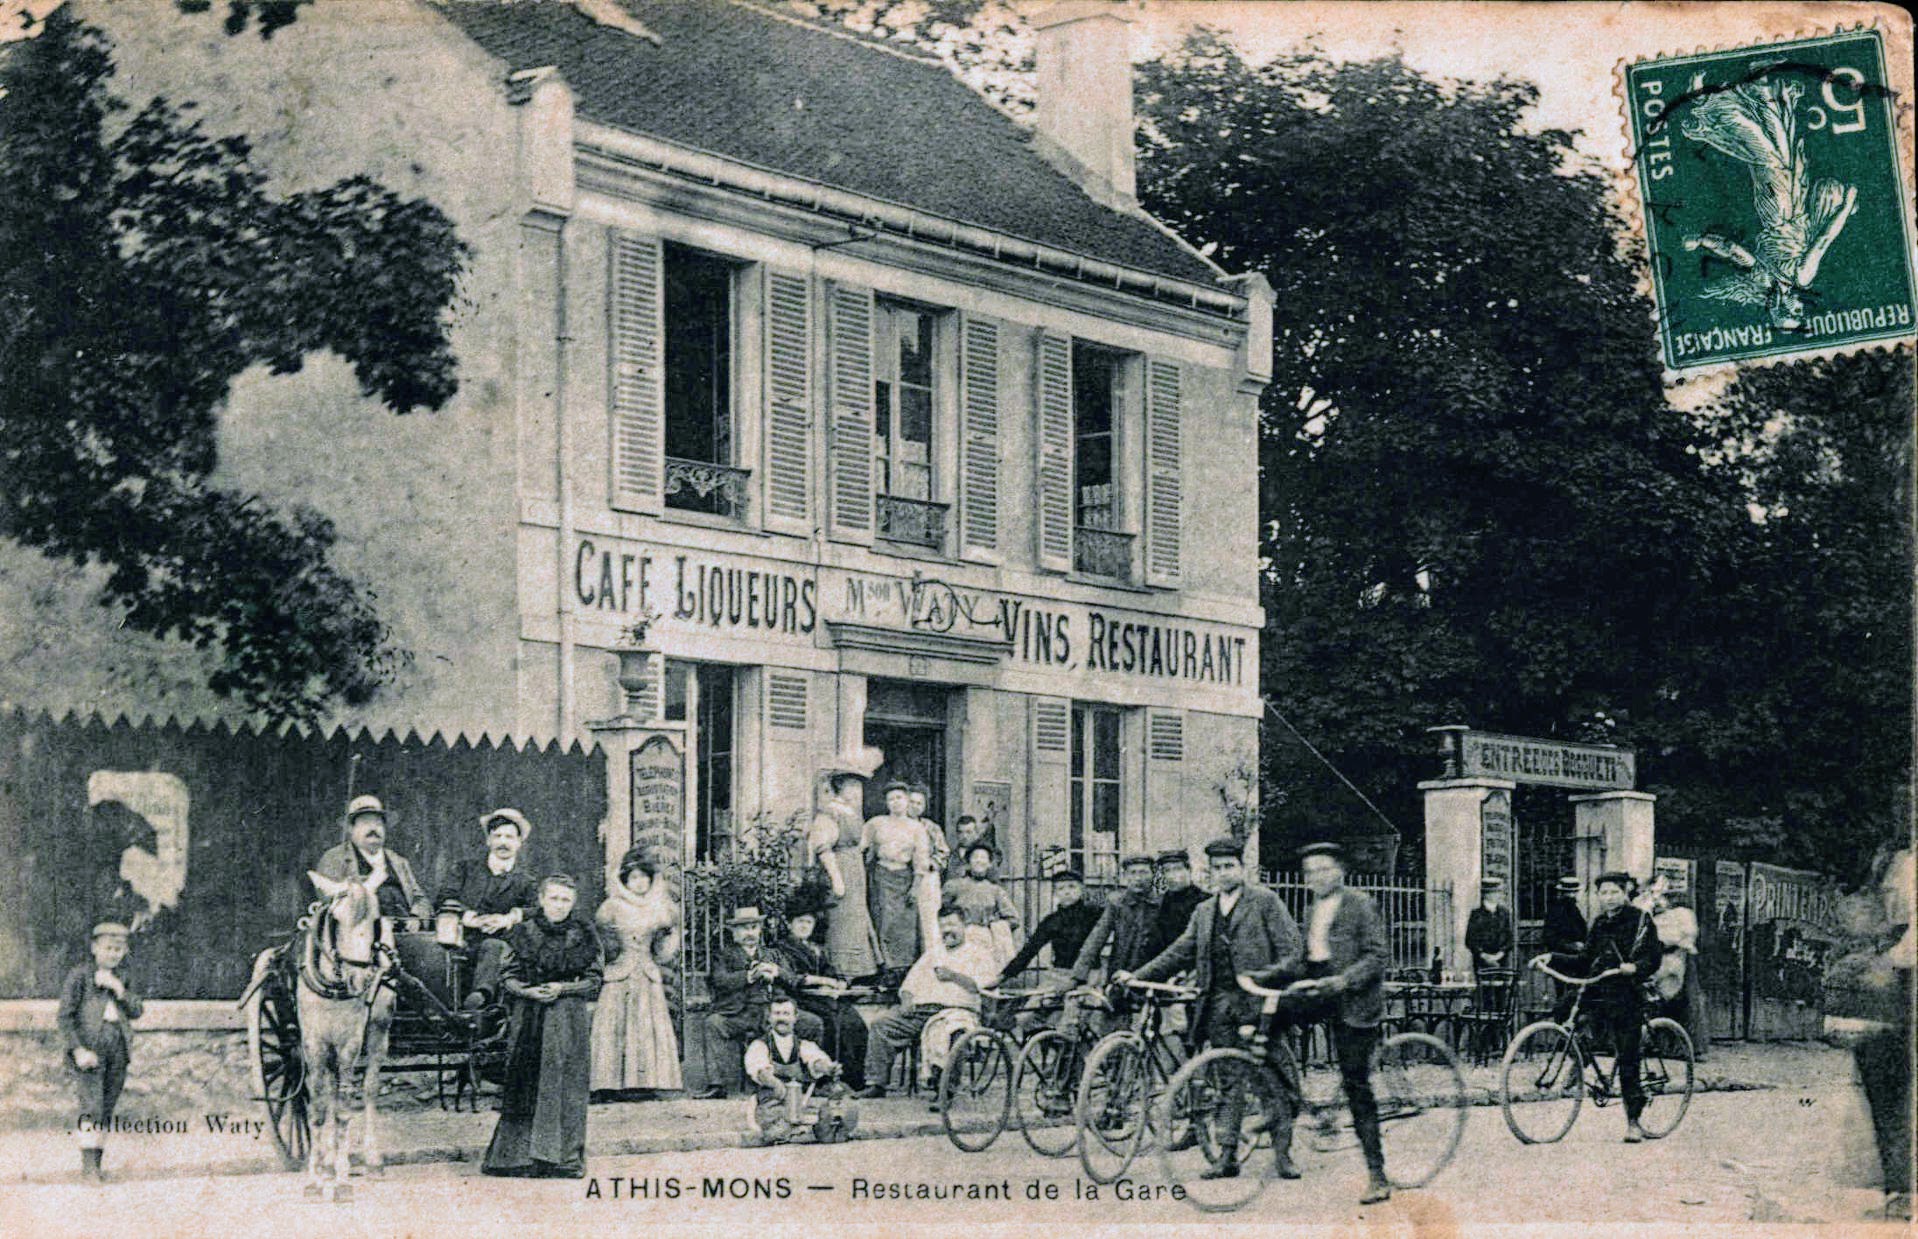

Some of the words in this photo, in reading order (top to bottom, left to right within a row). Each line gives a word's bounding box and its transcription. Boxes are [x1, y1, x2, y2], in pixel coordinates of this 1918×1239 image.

[1640, 80, 1675, 181] POSTES
[1822, 67, 1867, 135] 5
[1804, 303, 1910, 338] REPUBLIQUE
[674, 554, 816, 635] LIQUEURS
[1087, 611, 1246, 685] RESTAURANT
